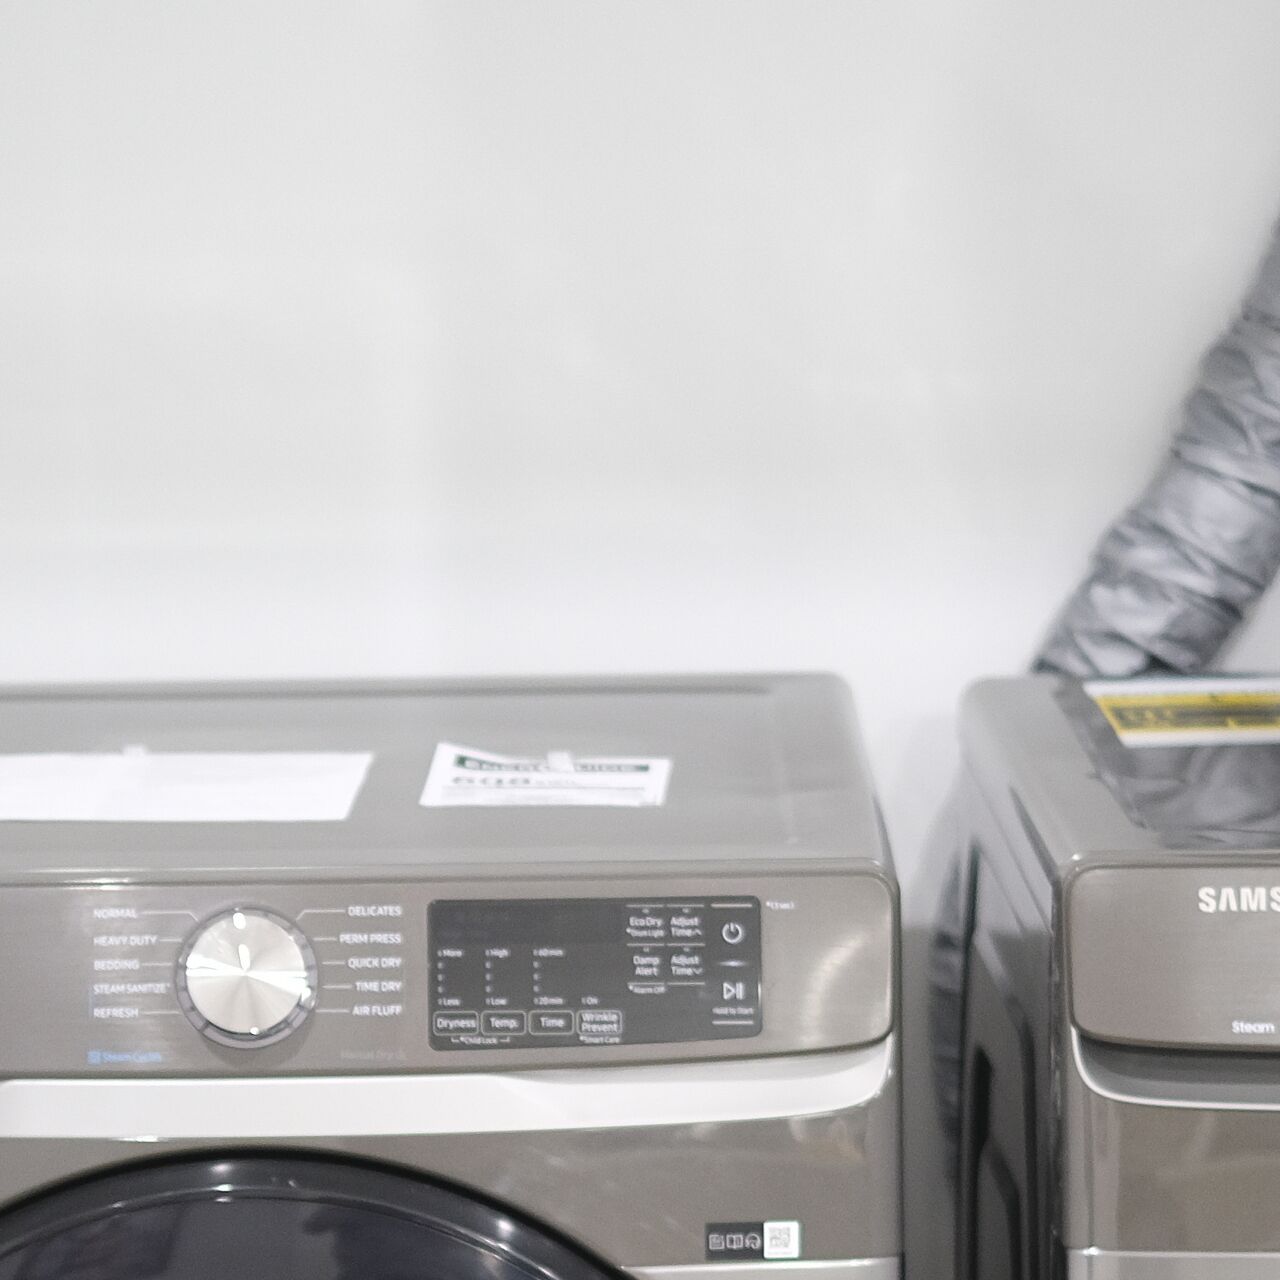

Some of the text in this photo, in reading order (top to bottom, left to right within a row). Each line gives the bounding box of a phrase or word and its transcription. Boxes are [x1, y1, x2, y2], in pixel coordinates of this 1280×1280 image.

[93, 908, 137, 919] NORMAL
[347, 905, 402, 917] DELICATES
[629, 917, 662, 927] Eco Dry
[670, 916, 699, 927] Adjust
[671, 927, 692, 938] Time
[93, 935, 158, 946] HEAVY DUTY
[340, 933, 402, 944] PERM PRESS
[93, 959, 140, 970] BEDDING
[348, 957, 402, 970] QUICK DRY
[633, 956, 660, 966] Damp
[670, 955, 699, 966] Adjust
[635, 966, 658, 976] Alert
[671, 966, 692, 976] Time
[93, 983, 125, 995] STEAM
[355, 981, 402, 992] TIME DRY
[94, 1008, 139, 1018] REFRESH
[352, 1005, 402, 1016] AIR FLUFF
[540, 1017, 565, 1028] Time
[581, 1012, 618, 1022] Wrinkle
[436, 1018, 477, 1030] Dryness
[490, 1017, 519, 1029] Temp.
[581, 1022, 618, 1033] Prevent
[1231, 1019, 1275, 1034] Steam
